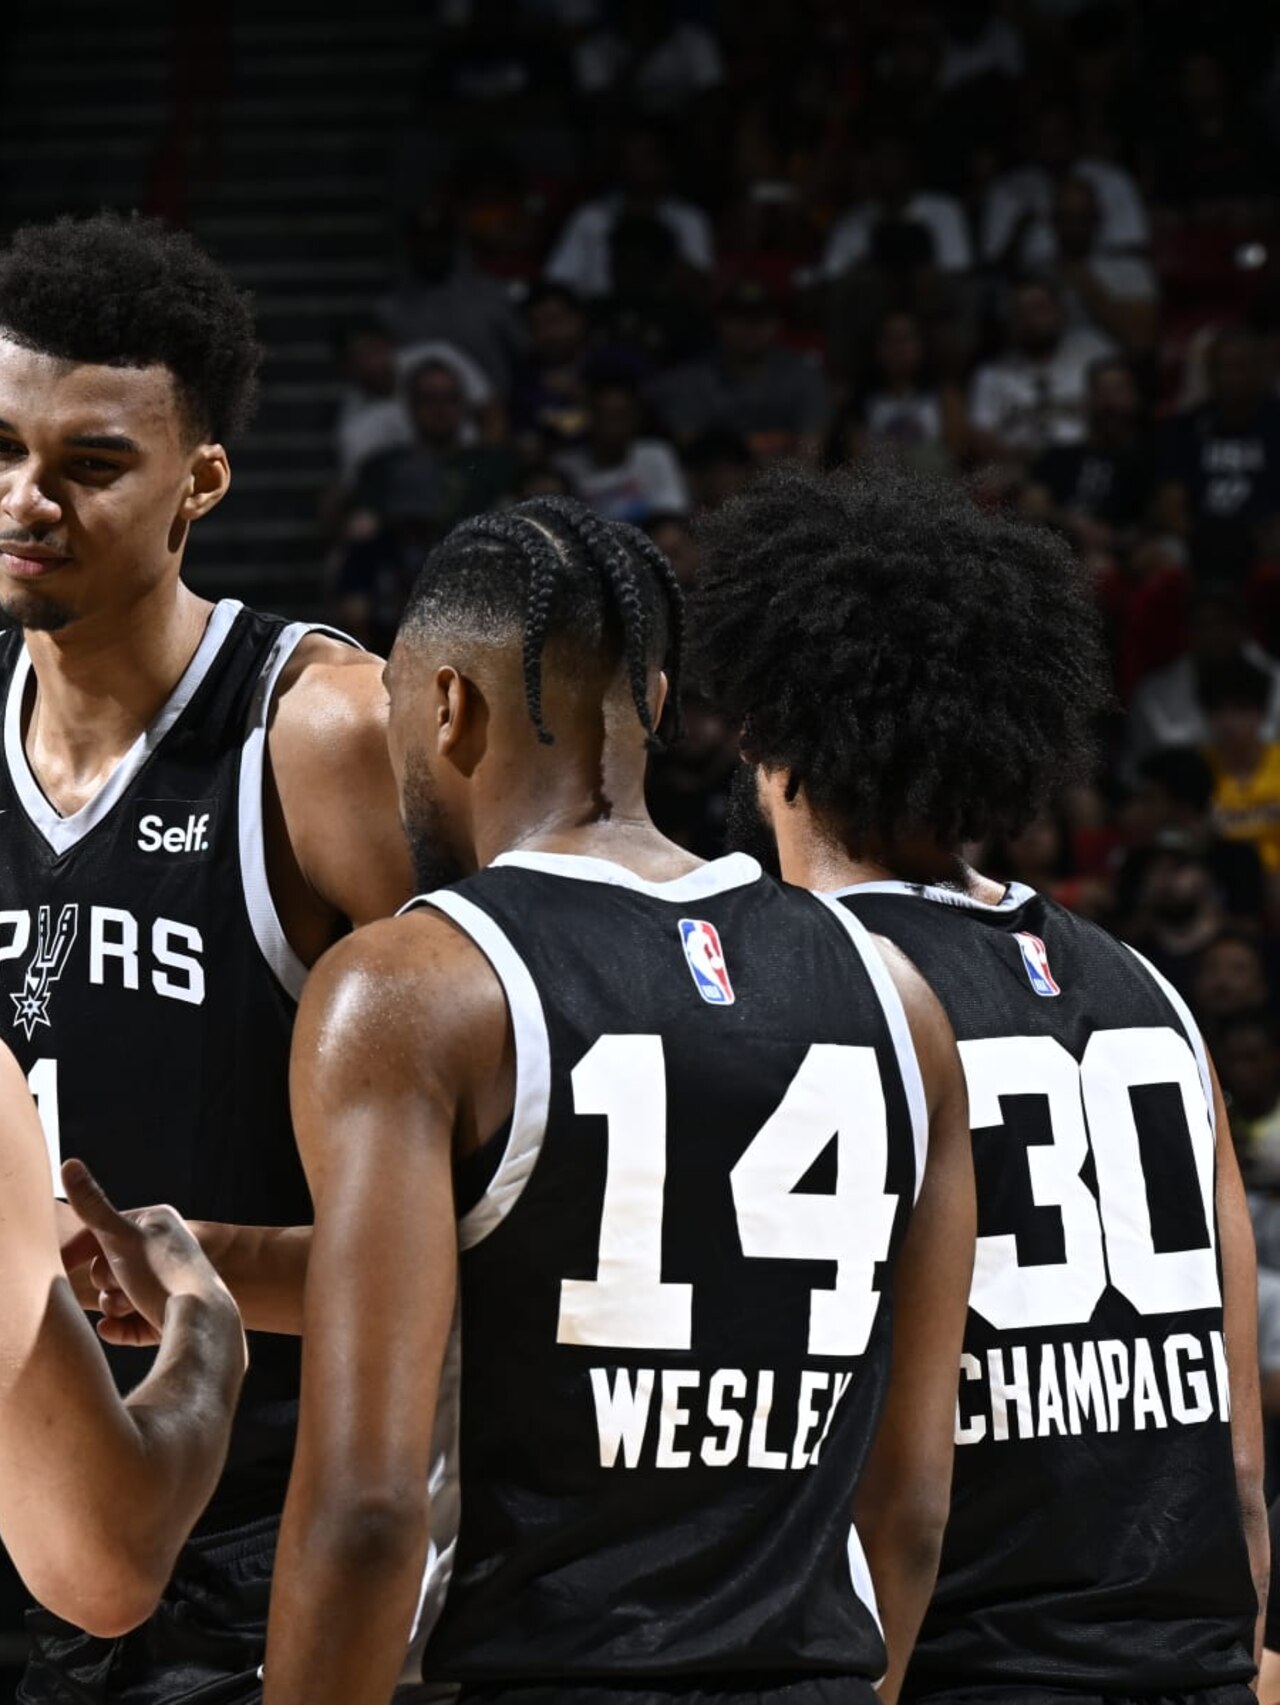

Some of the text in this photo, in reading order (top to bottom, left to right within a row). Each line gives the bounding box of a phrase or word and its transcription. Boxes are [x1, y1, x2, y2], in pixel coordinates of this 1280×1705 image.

[137, 813, 211, 853] Self.
[556, 1033, 899, 1357] 14
[956, 1026, 1223, 1331] 30
